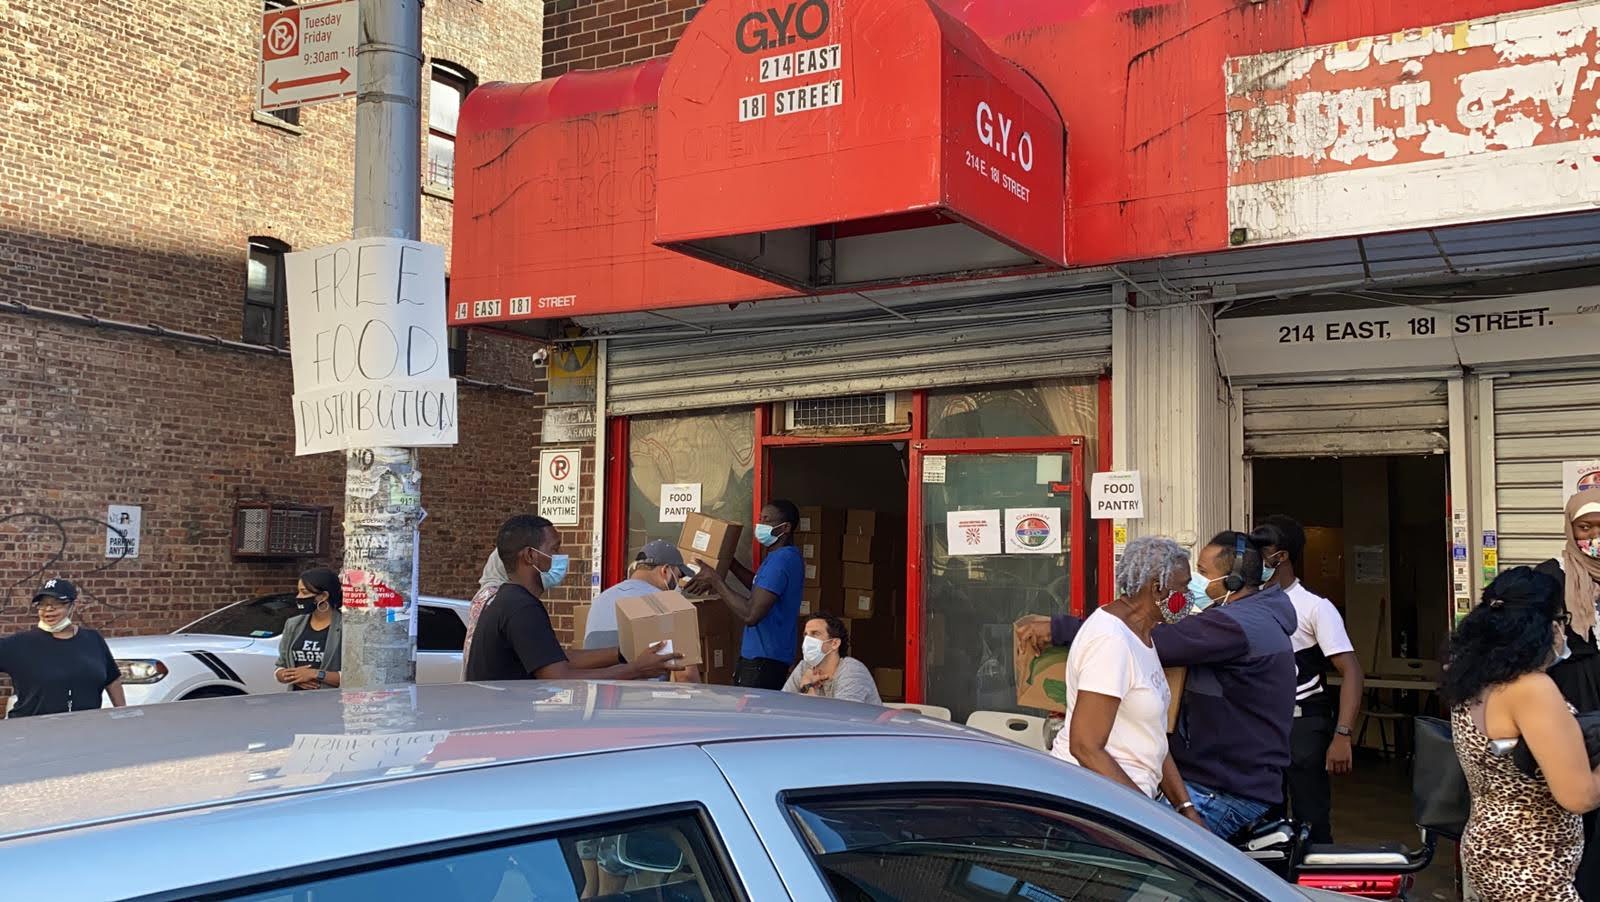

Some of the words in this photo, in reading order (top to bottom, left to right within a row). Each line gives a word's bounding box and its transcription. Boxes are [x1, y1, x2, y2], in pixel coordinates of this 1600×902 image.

[305, 14, 341, 29] Tuesday
[304, 31, 332, 44] Friday
[304, 50, 339, 65] 9:30am
[761, 56, 791, 79] 214
[797, 46, 839, 74] EAST
[776, 82, 841, 114] STREET
[976, 101, 1033, 171] G.Y.O
[965, 150, 979, 171] 214
[1002, 174, 1030, 203] STREET
[311, 244, 425, 312] FREE
[474, 301, 500, 317] EAST
[511, 298, 530, 314] 181
[537, 295, 577, 309] STREET
[1278, 325, 1315, 344] 214
[1326, 320, 1391, 341] EAST,
[313, 319, 439, 384] FOOD
[300, 388, 455, 447] DISTRIBUTION
[553, 484, 565, 494] NO
[1104, 483, 1135, 494] FOOD
[541, 496, 576, 505] PARKING
[670, 493, 693, 502] FOOD
[541, 507, 576, 516] ANYTIME
[1098, 500, 1140, 511] PANTRY
[302, 640, 321, 651] EL
